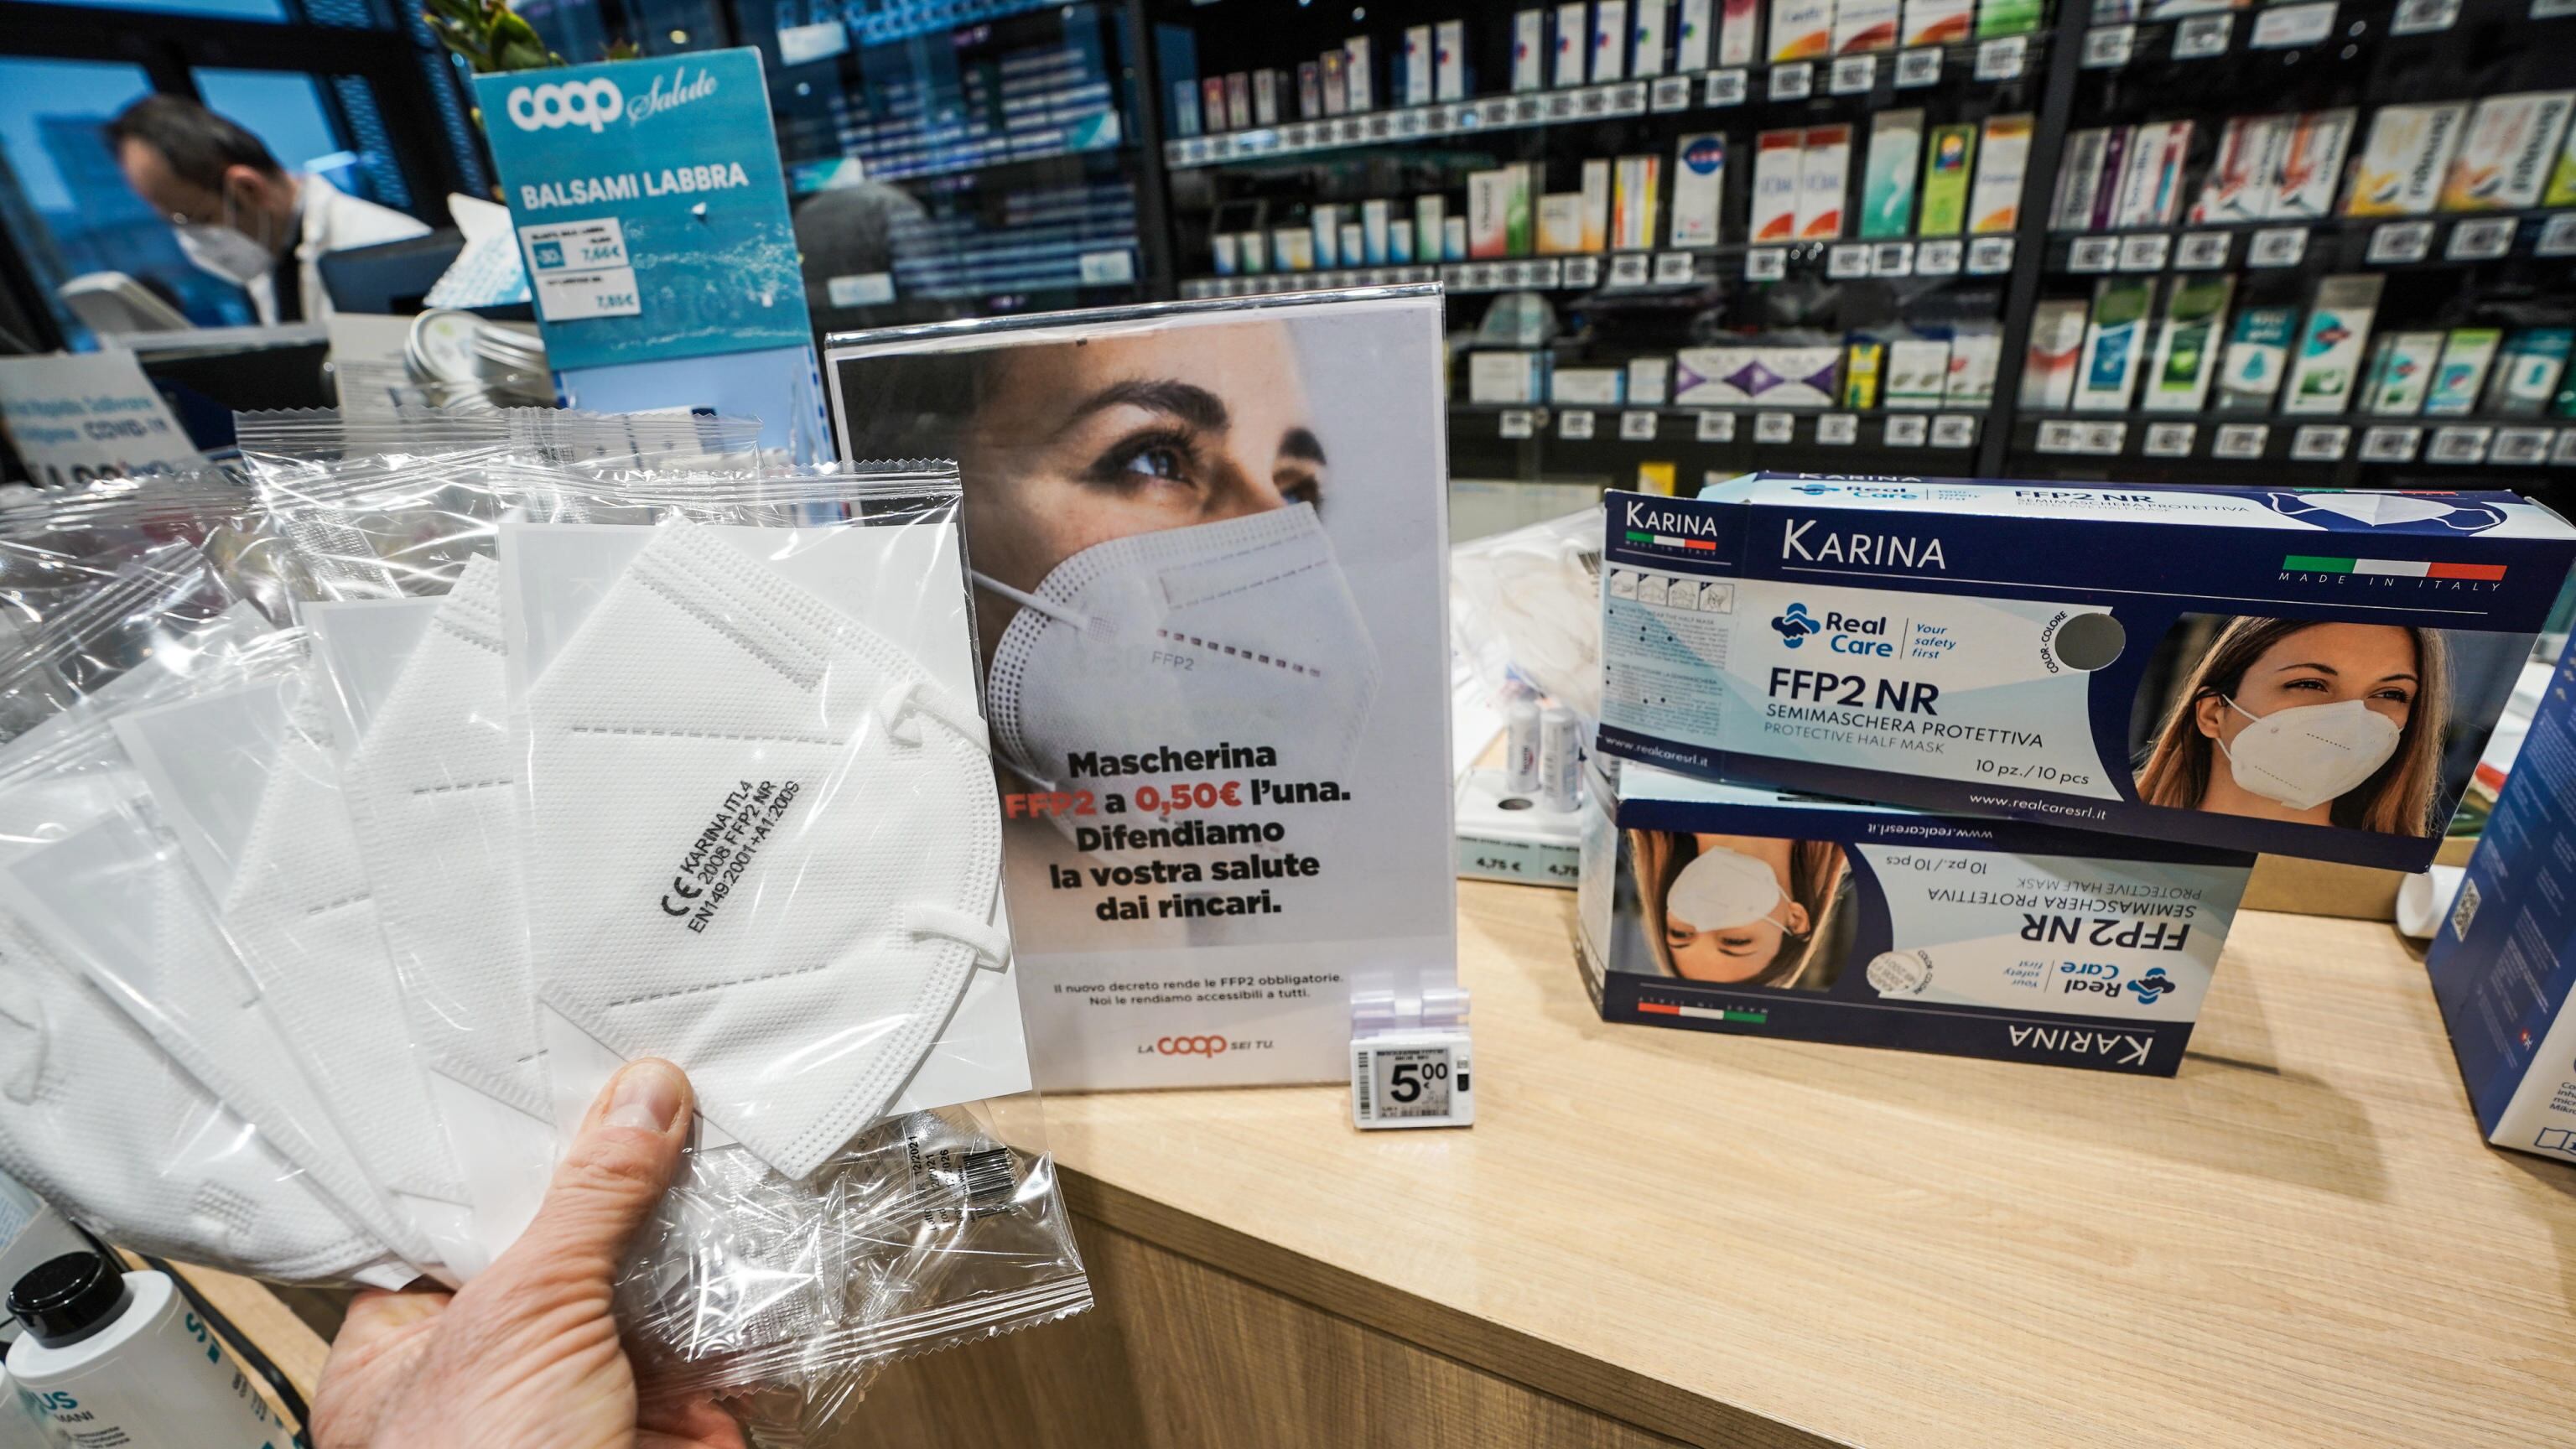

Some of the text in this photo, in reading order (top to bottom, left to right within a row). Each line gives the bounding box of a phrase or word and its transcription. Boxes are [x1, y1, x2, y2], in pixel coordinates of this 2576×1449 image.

[507, 66, 719, 132] coop Salute
[521, 162, 749, 210] BALSAMI LABBRA
[2015, 491, 2155, 503] FFP2 NR
[1627, 501, 1718, 538] KARINA
[1783, 519, 1945, 569] KARINA
[2279, 573, 2501, 592] MADE IN ITALY
[1826, 611, 1887, 636] Real
[1916, 623, 1948, 636] Your
[1831, 635, 1893, 658] Care
[1912, 647, 1940, 660] first
[1914, 636, 1956, 651] safety
[1151, 650, 1195, 672] FFP2
[1768, 667, 1866, 708] FFP2
[1875, 678, 1940, 715] NR
[1764, 722, 1945, 755] PROTECTIVE HALF MASK
[1766, 704, 2043, 749] SEMIMASCHERA PROTETTIVA
[1067, 742, 1276, 778] Mascherina
[1604, 735, 1709, 768] www.realcaresrl.it
[1976, 759, 1994, 773] 10
[2059, 772, 2090, 787] pcs
[1005, 779, 1351, 819] FFP2 a 0,50€ l'una.
[1970, 793, 2107, 821] www.realcaresrl.it
[680, 812, 732, 875] KARINA
[723, 780, 753, 816] ITL4
[697, 780, 776, 886] 2008 FFP2 NR
[1076, 821, 1285, 852] Difendiamo
[1867, 823, 1993, 839] www.realcaresrl.it
[1050, 854, 1320, 889] la vostra salute
[1886, 855, 1911, 868] pcs
[1971, 861, 1987, 875] 10
[1928, 887, 2197, 918] SEMIMASCHERA PROTETTIVA
[2017, 877, 2203, 901] PROTECTIVE HALF MASK
[1096, 890, 1282, 921] dai rincari.
[2019, 912, 2191, 951] FFP2 NR
[2003, 966, 2041, 979] safety
[2018, 959, 2044, 969] first
[2060, 961, 2120, 980] Care
[1066, 984, 1105, 994] nuovo
[1109, 981, 1159, 992] decreto
[1163, 979, 1201, 989] rende
[1204, 978, 1217, 989] le
[1220, 976, 1254, 987] FFP2
[1089, 995, 1113, 1006] Noi
[1115, 995, 1127, 1005] le
[1130, 993, 1192, 1005] rendiamo
[1196, 989, 1264, 1003] accessibili
[1278, 989, 1311, 1000] tutti.
[2064, 979, 2122, 998] Real
[1137, 1045, 1154, 1055] LA
[1157, 1034, 1227, 1058] coop
[1231, 1041, 1252, 1050] SEI
[2009, 1025, 2153, 1067] KARINA
[908, 1136, 922, 1176] 12/2021
[940, 1149, 955, 1189] 122026
